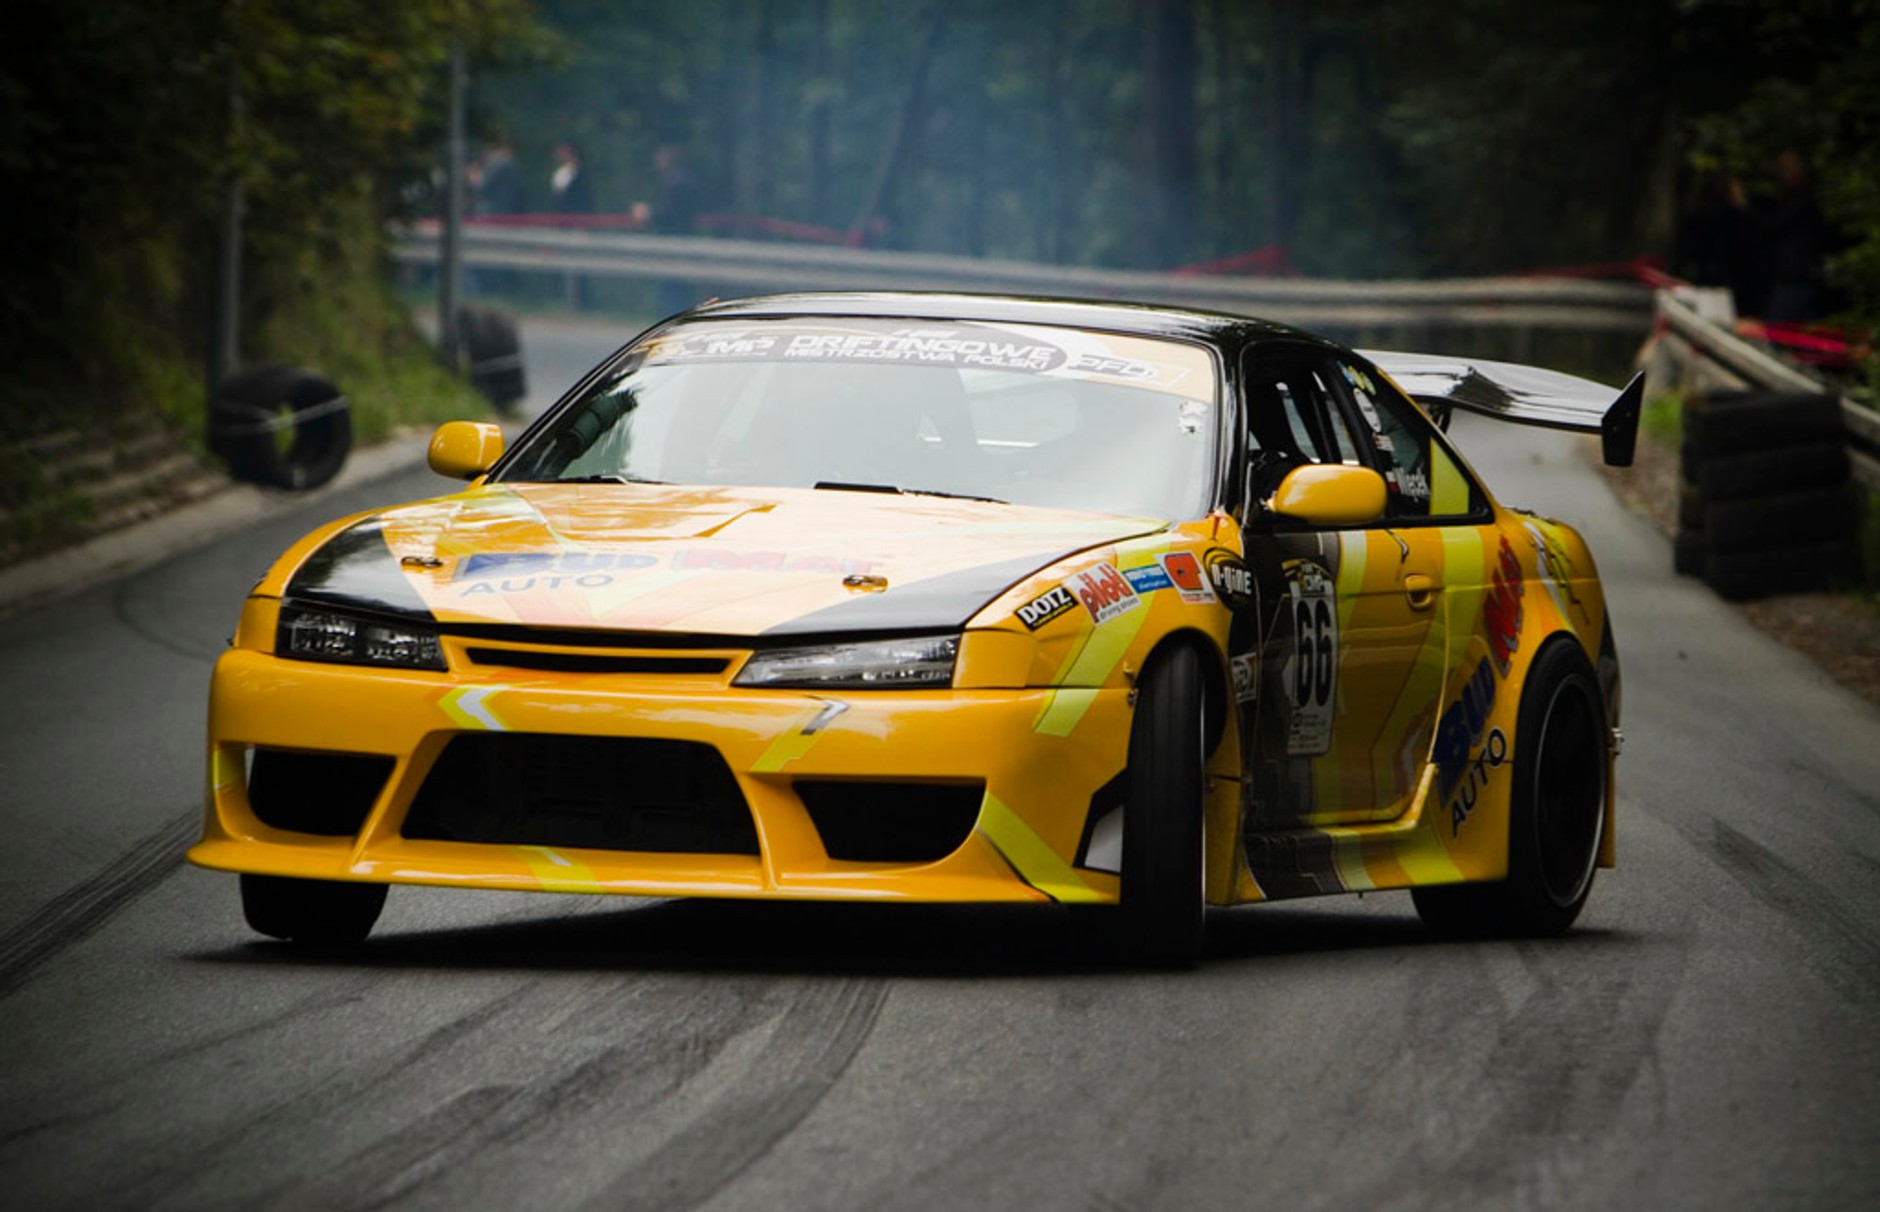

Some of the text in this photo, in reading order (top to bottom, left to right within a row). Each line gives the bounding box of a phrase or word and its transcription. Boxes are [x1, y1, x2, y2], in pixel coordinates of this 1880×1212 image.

[787, 335, 1058, 358] DRIFTINGOWE
[963, 353, 1049, 370] POLSKI
[451, 547, 883, 582] BUD MAT
[458, 574, 614, 598] AUTO
[1016, 588, 1072, 625] DOTZ
[1296, 599, 1332, 707] 66
[1432, 655, 1496, 810] BUD
[1451, 728, 1507, 838] AUTO
